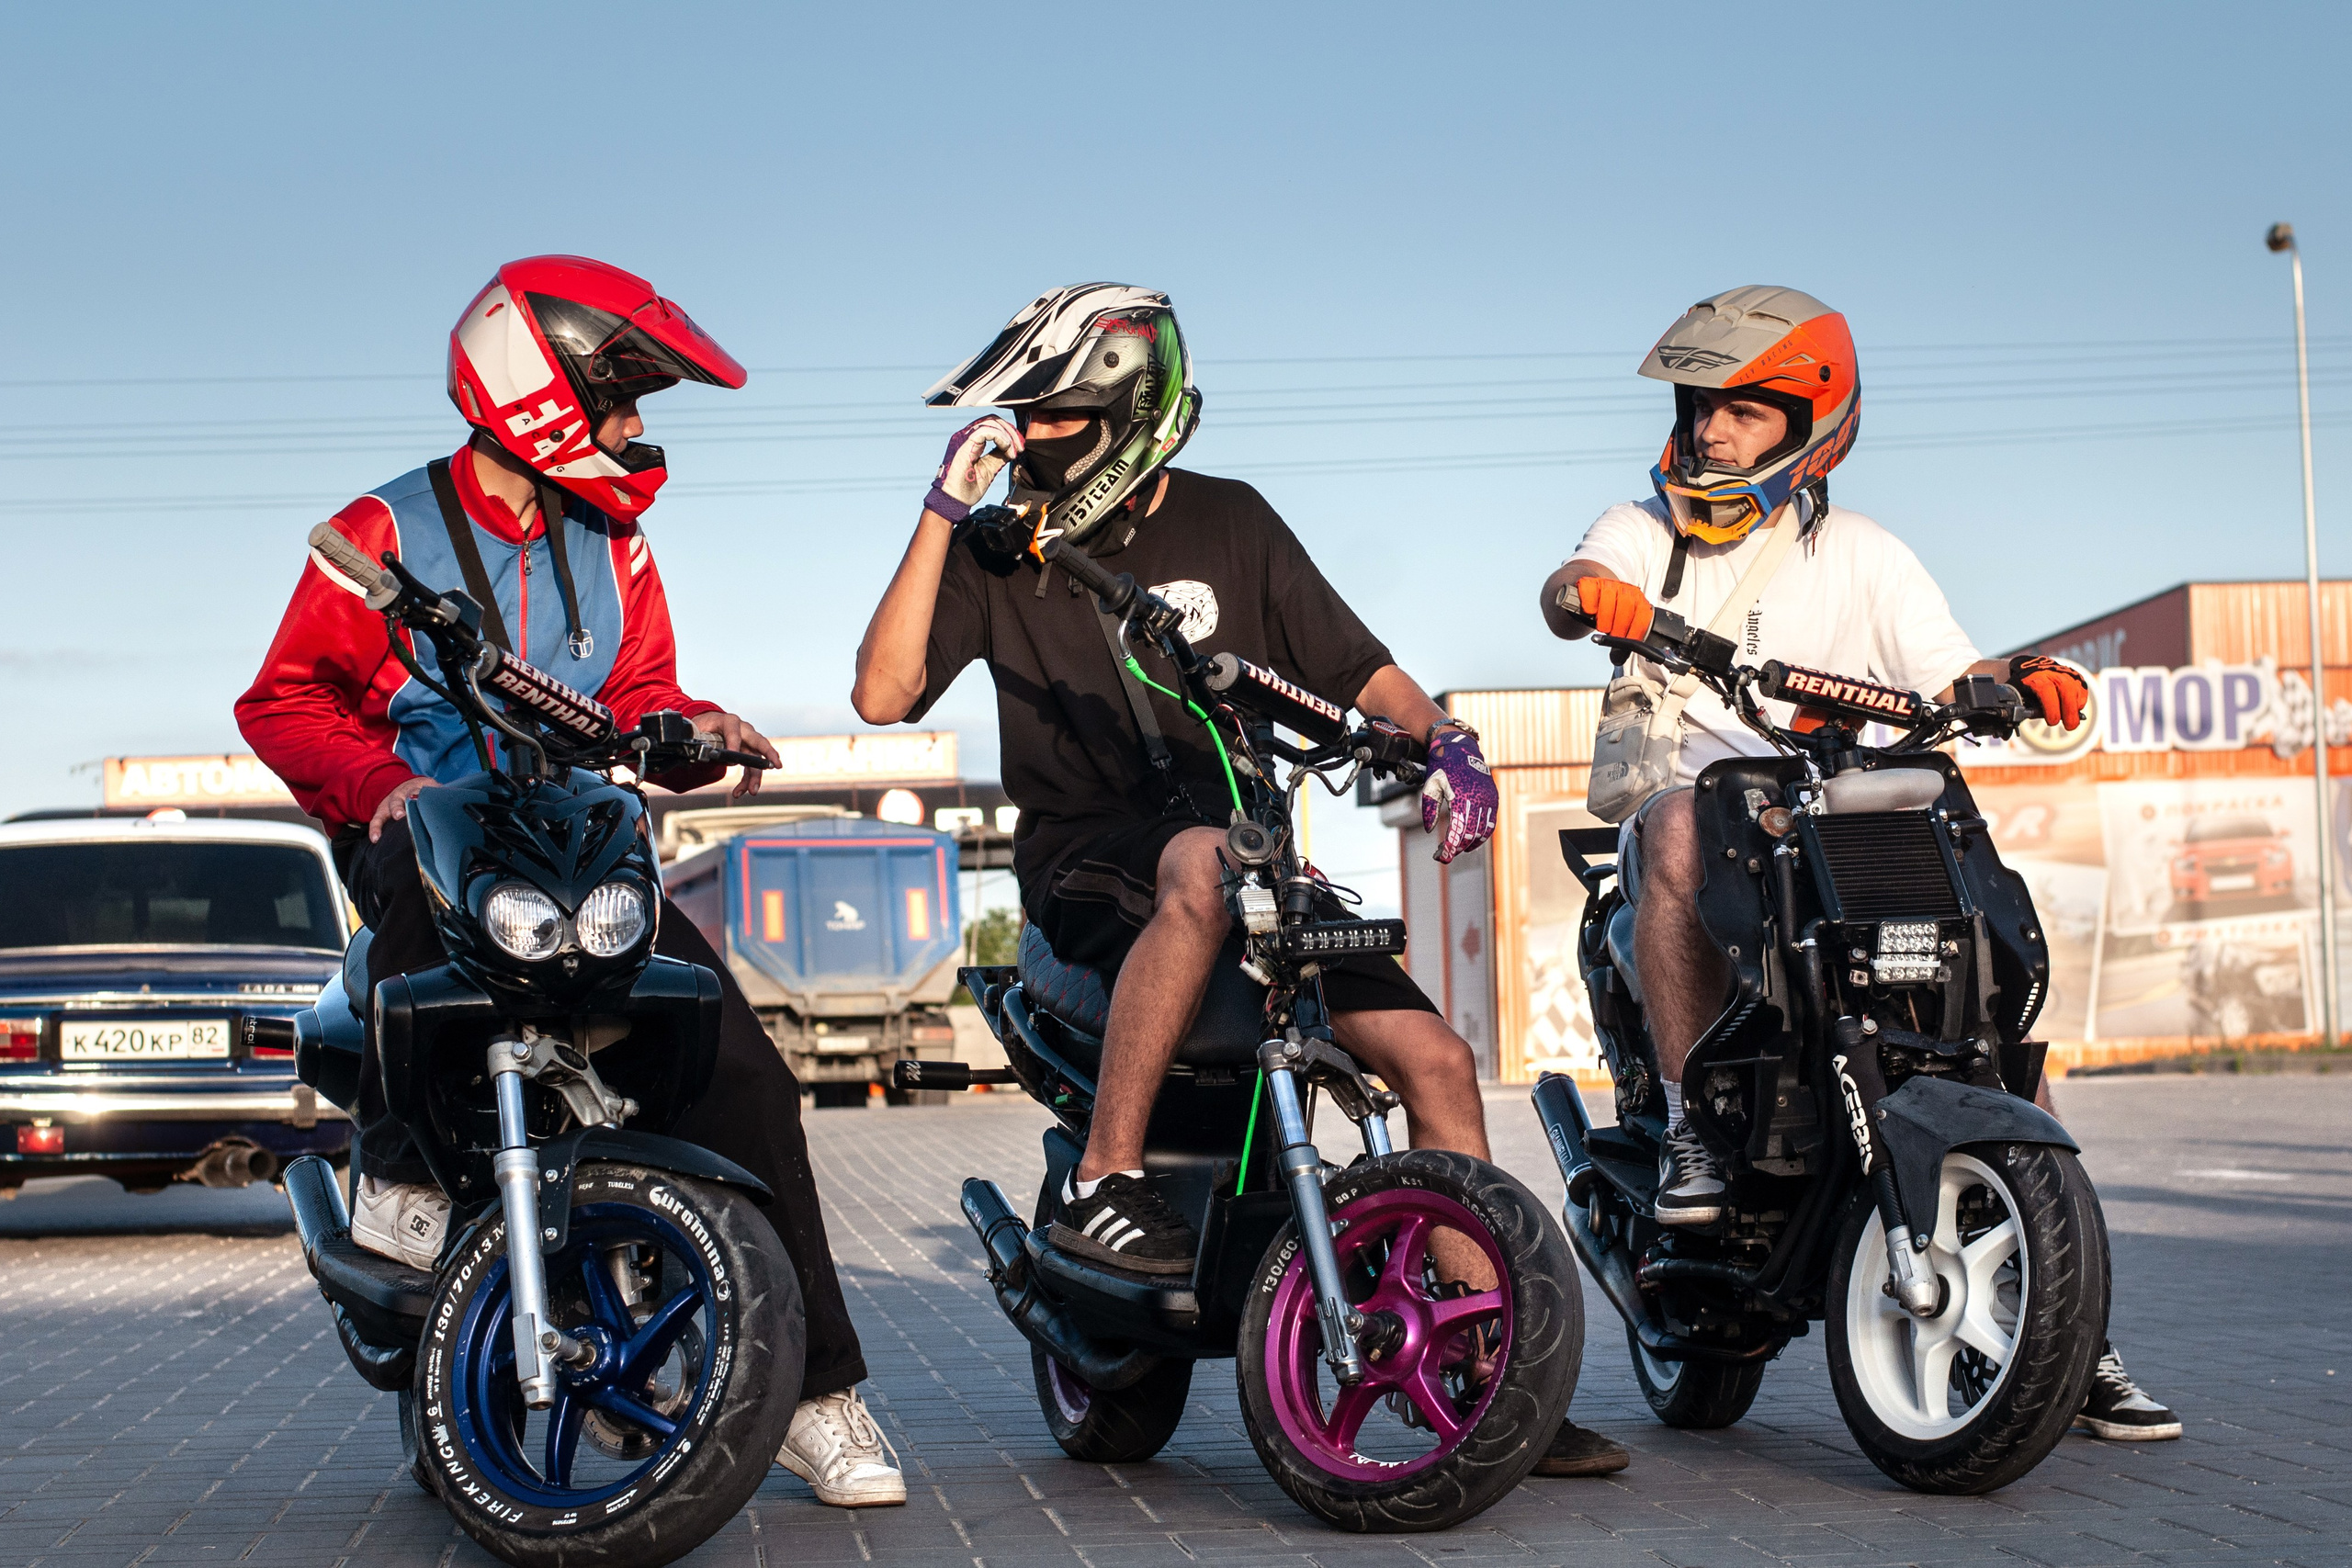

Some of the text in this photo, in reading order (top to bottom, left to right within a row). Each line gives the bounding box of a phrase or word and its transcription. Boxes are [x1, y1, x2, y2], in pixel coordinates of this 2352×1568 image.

[513, 402, 566, 474] RACING
[492, 670, 602, 739] RENTHAL
[1242, 660, 1341, 723] RENTHAL
[1784, 671, 1913, 716] RENTHAL
[191, 1027, 219, 1045] 82
